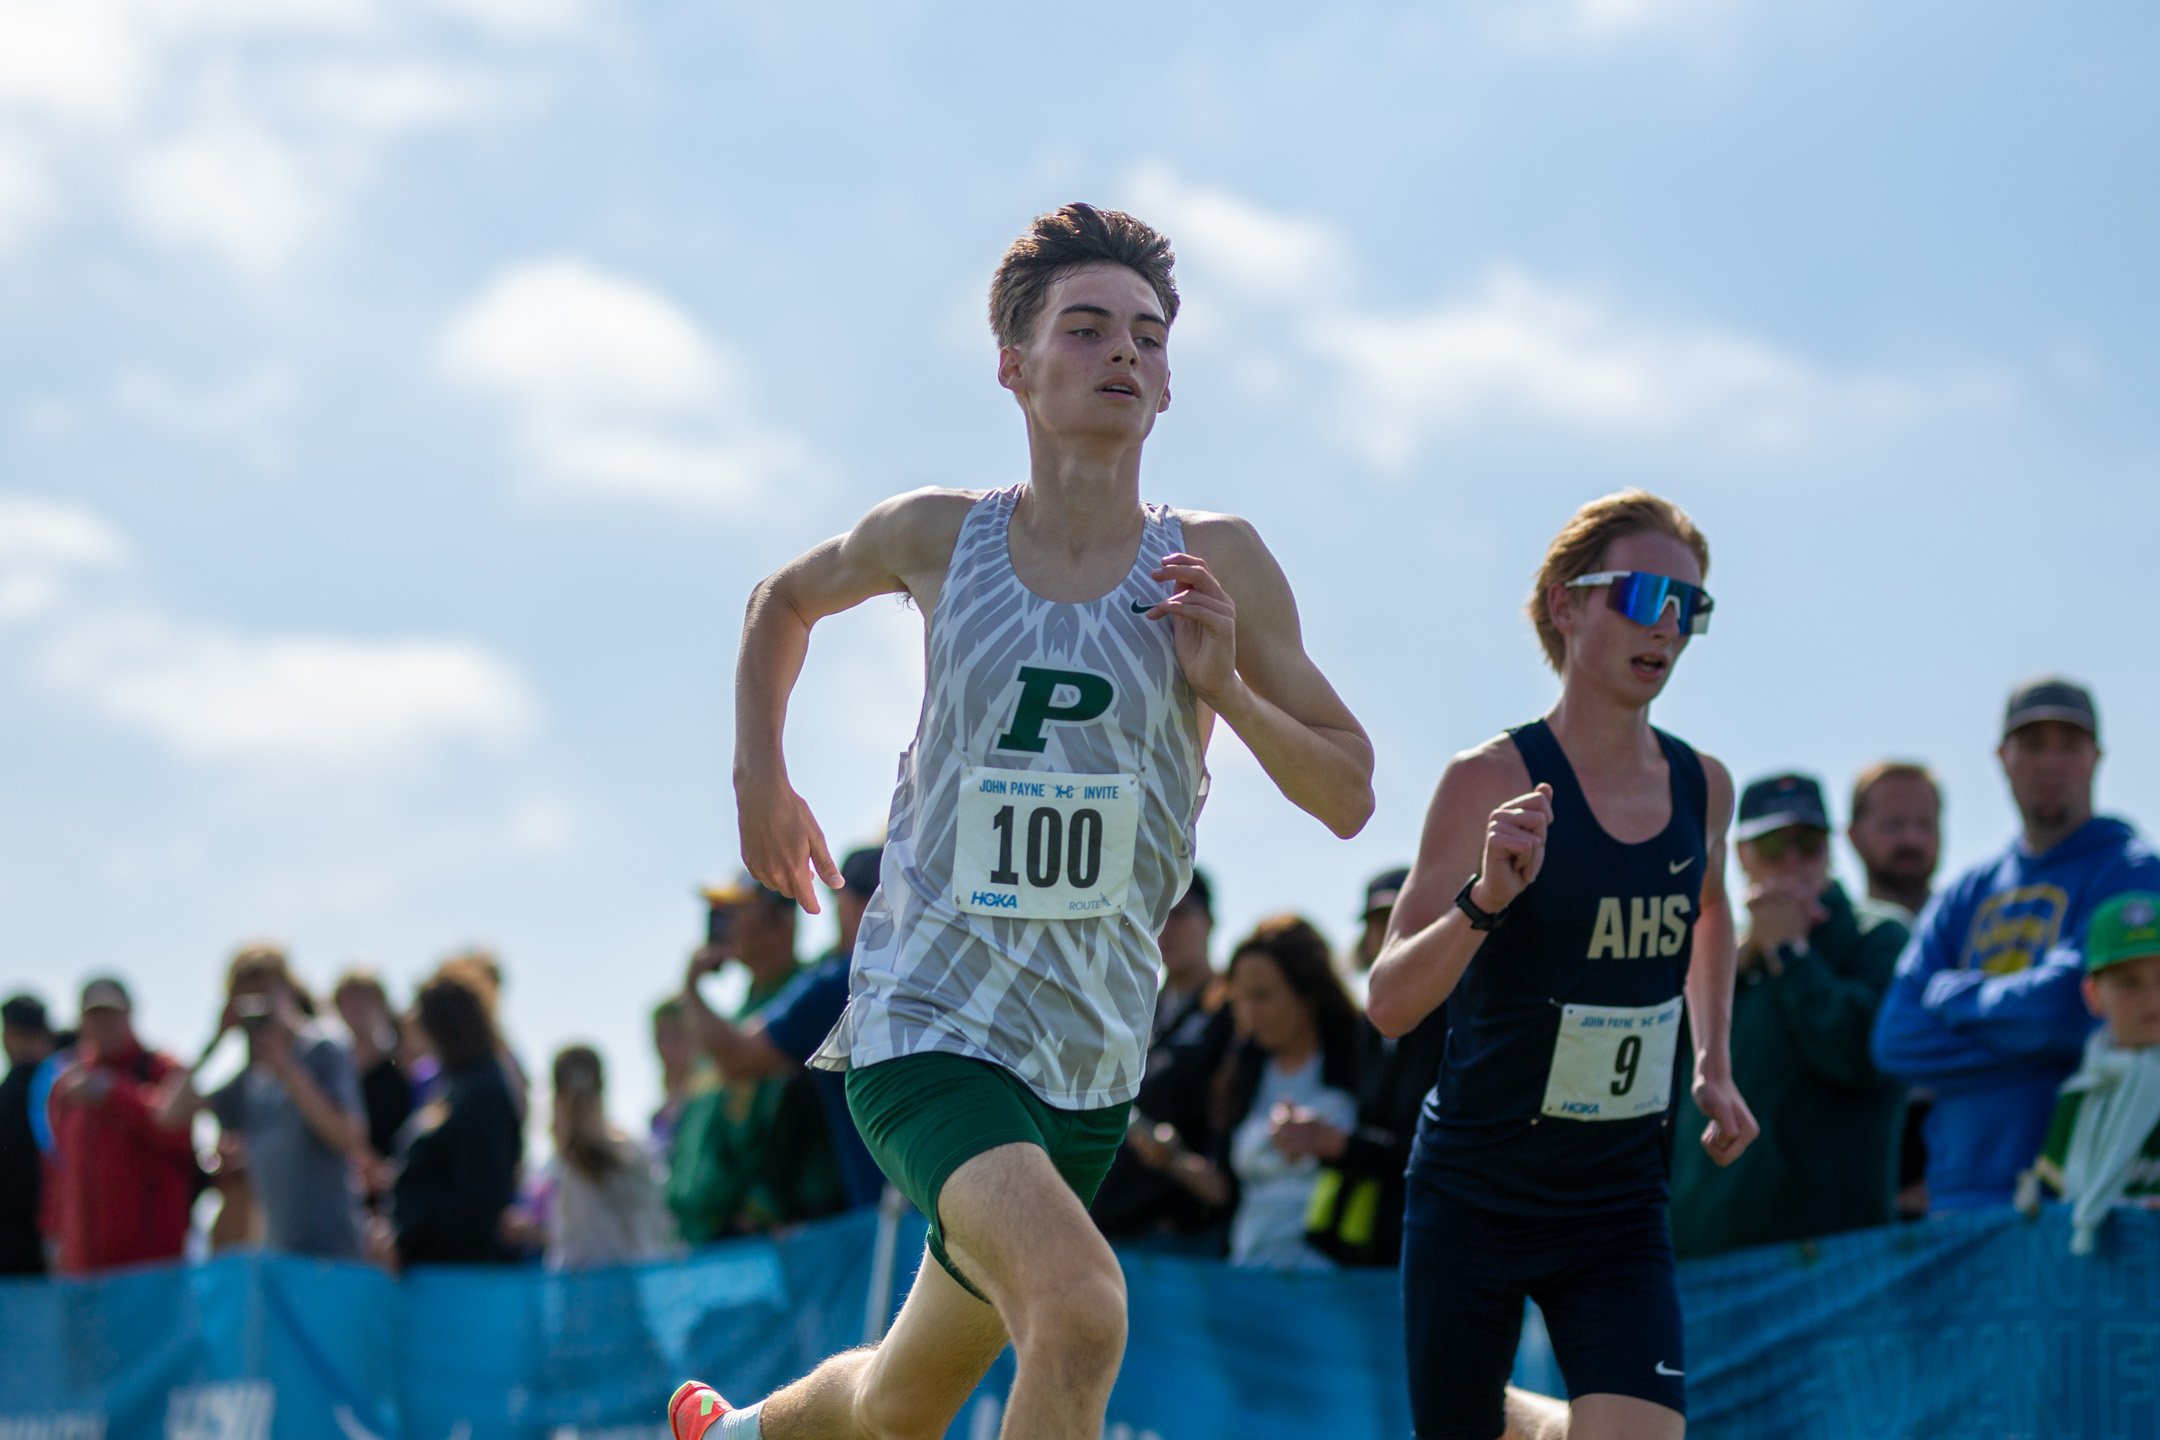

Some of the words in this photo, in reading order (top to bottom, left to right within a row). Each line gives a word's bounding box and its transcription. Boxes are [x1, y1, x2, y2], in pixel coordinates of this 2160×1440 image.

[996, 666, 1114, 754] P
[979, 779, 1007, 795] JOHN
[1010, 782, 1045, 798] PAYNE
[1084, 785, 1119, 800] INVITE
[990, 805, 1103, 889] 100
[971, 891, 1018, 909] HOKA
[1587, 895, 1691, 960] AHS
[1581, 1015, 1605, 1028] JOHN
[1610, 1035, 1642, 1097] 9
